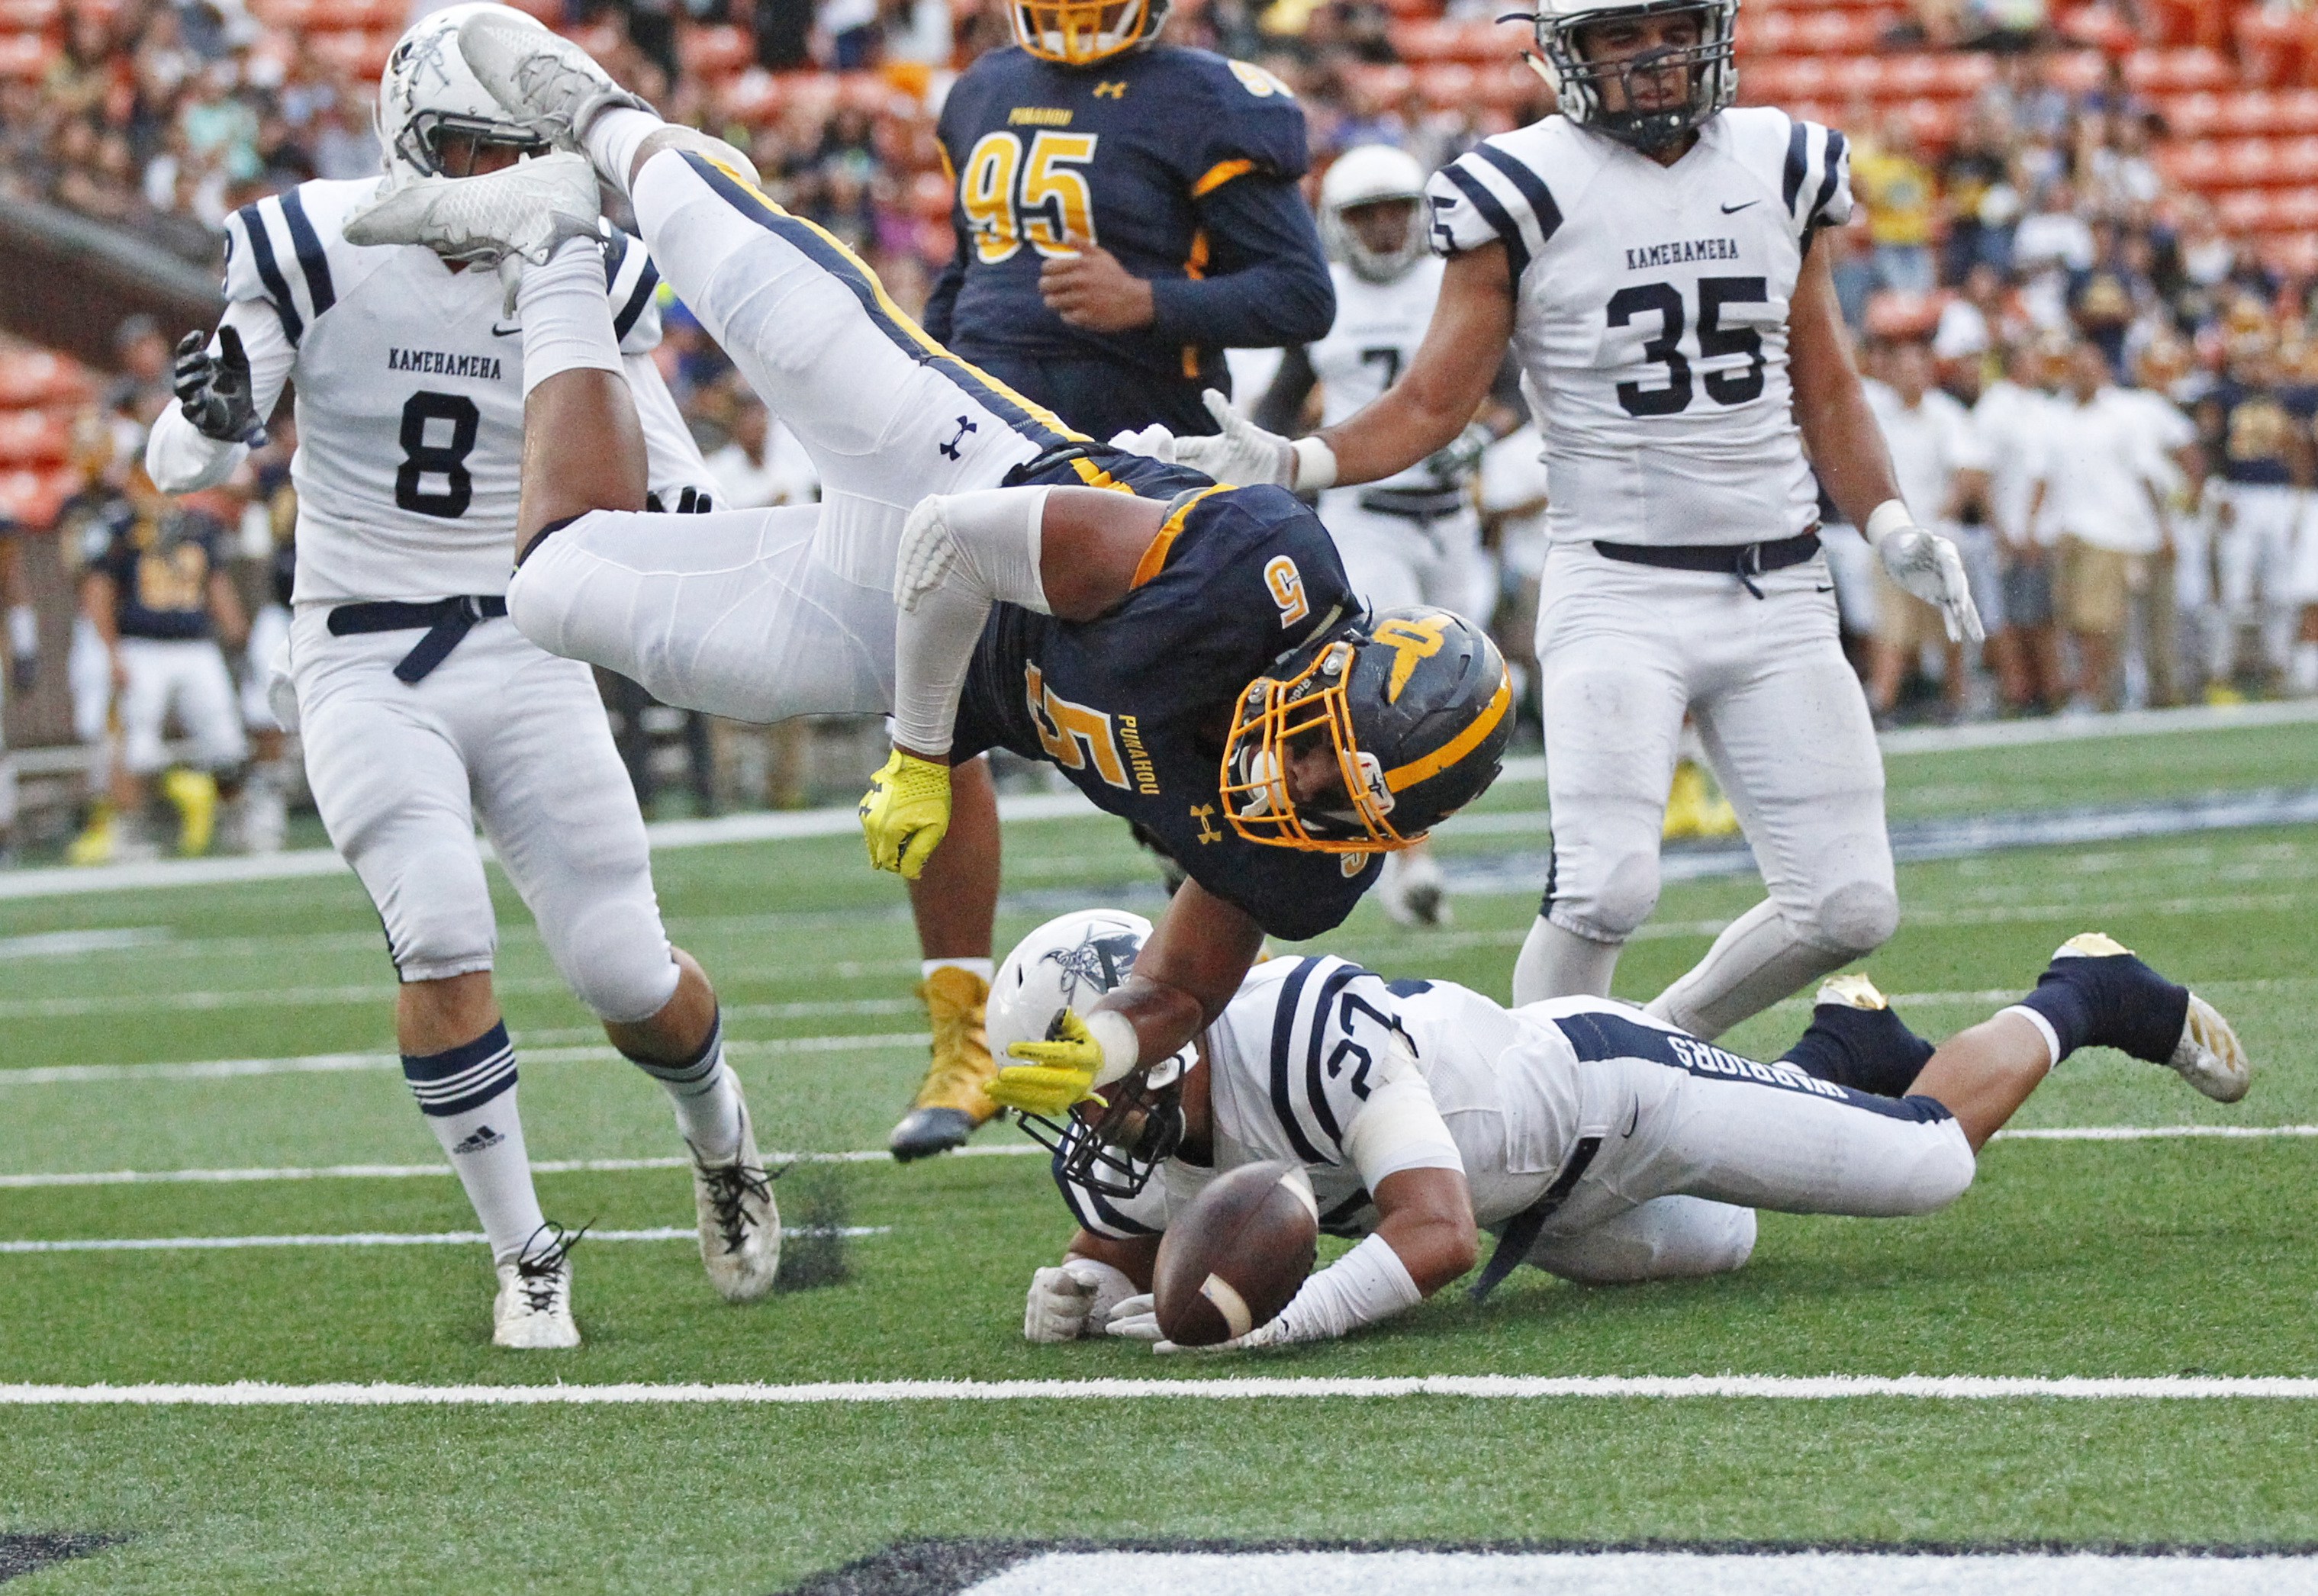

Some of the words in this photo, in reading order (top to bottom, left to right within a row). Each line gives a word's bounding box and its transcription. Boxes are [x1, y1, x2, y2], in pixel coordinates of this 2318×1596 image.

[960, 130, 1099, 265] 95
[1626, 238, 1740, 270] KAMEHAMEHA
[388, 347, 502, 379] KAMEHAMEHA
[1360, 347, 1400, 391] 7
[1606, 276, 1769, 417] 35
[395, 390, 480, 518] 8
[1264, 555, 1309, 629] 5
[1025, 658, 1132, 790] 5
[1119, 715, 1161, 795] PUNAHOU
[1327, 992, 1393, 1102] 27
[1666, 1035, 1850, 1099] WARRIORS
